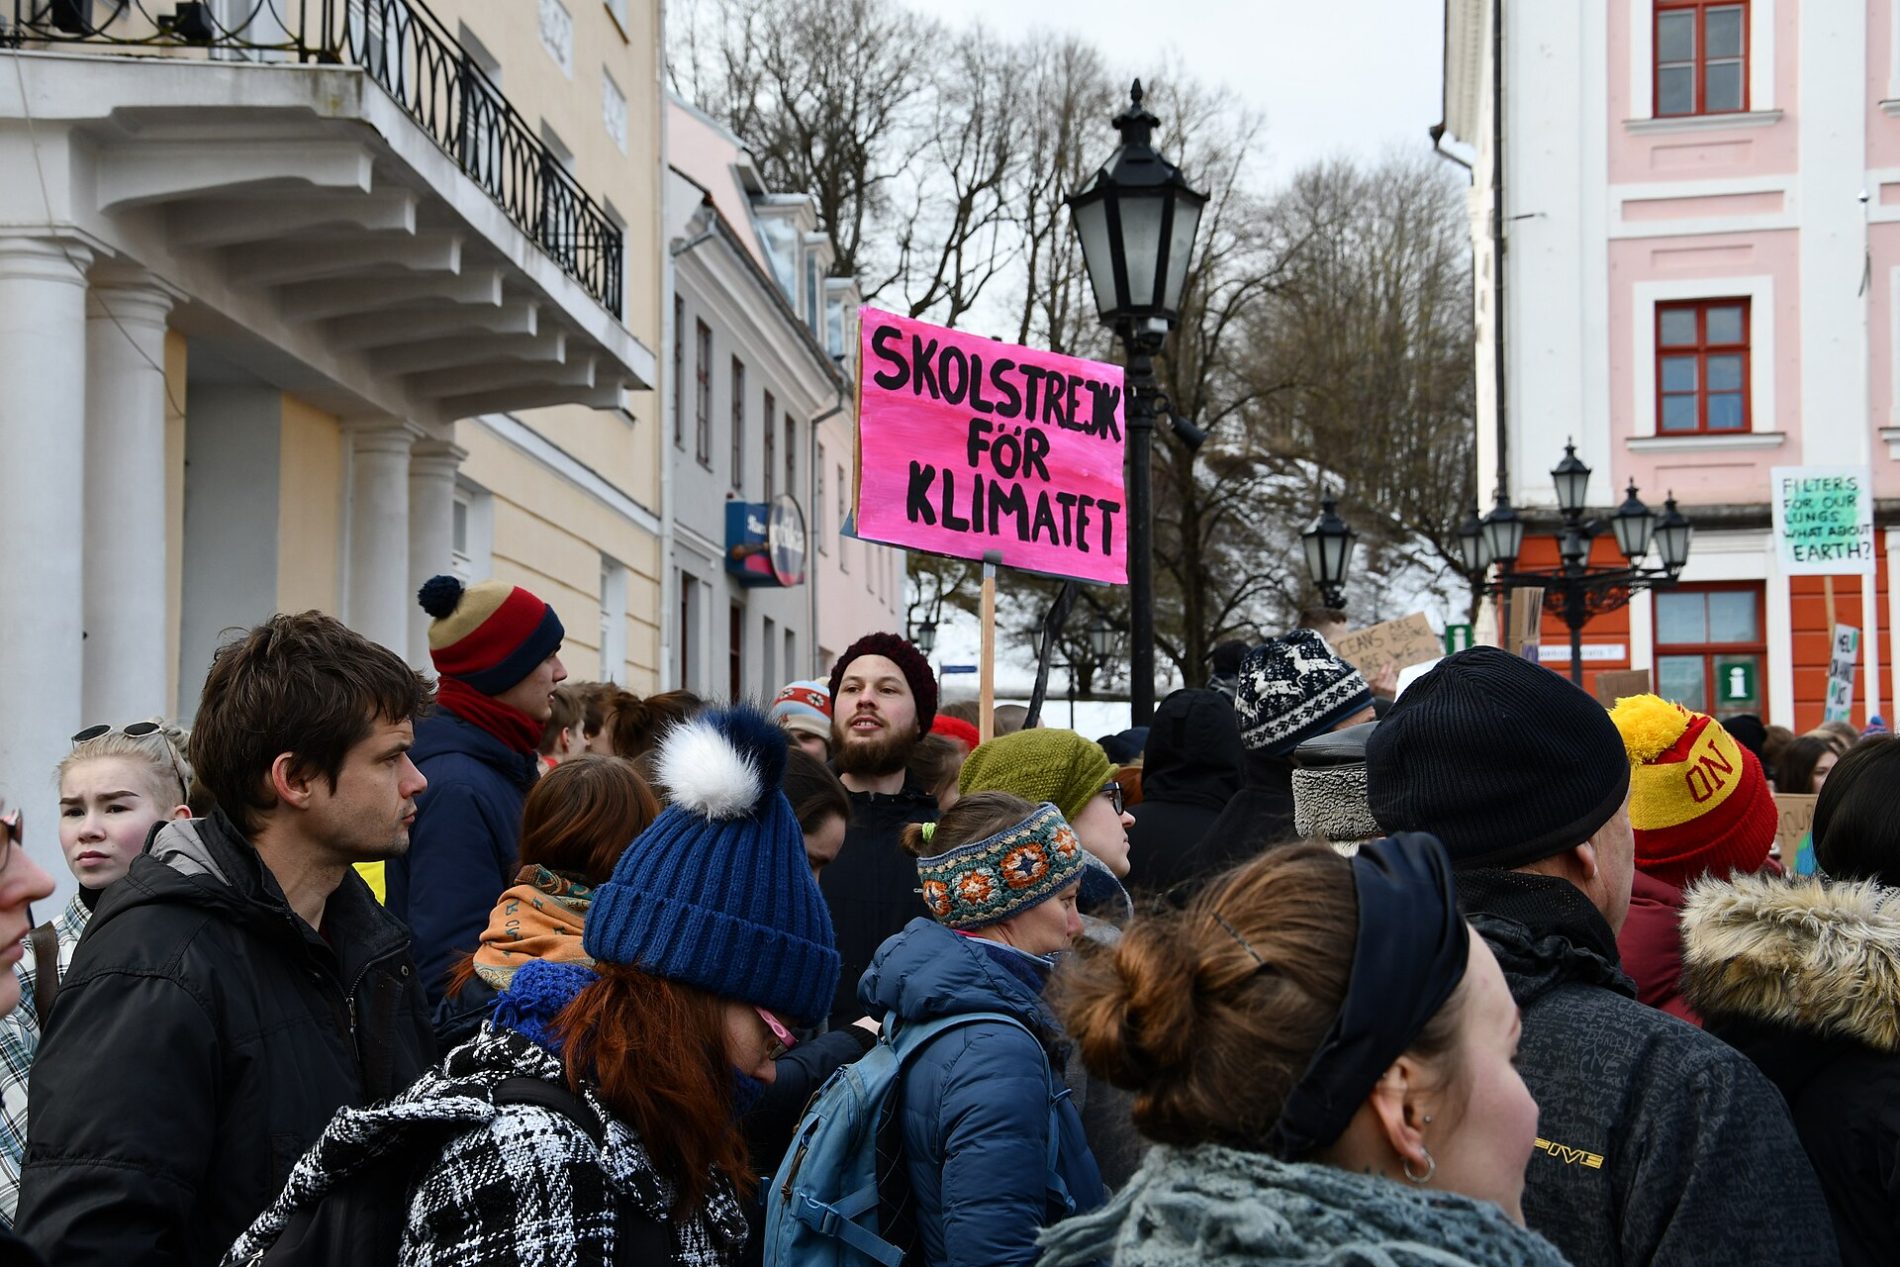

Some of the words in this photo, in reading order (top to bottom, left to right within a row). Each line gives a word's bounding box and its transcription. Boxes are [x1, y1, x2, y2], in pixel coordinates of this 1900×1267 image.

[872, 325, 1121, 443] SKOLSTREJK
[967, 417, 1051, 482] FÖR
[1783, 476, 1858, 494] FILTERS
[907, 460, 1121, 556] KLIMATET
[1783, 498, 1812, 510] FOR
[1822, 495, 1857, 510] OUR
[1783, 526, 1823, 538] WHAT
[1827, 523, 1872, 537] ABOUT
[1793, 541, 1872, 562] EARTH?
